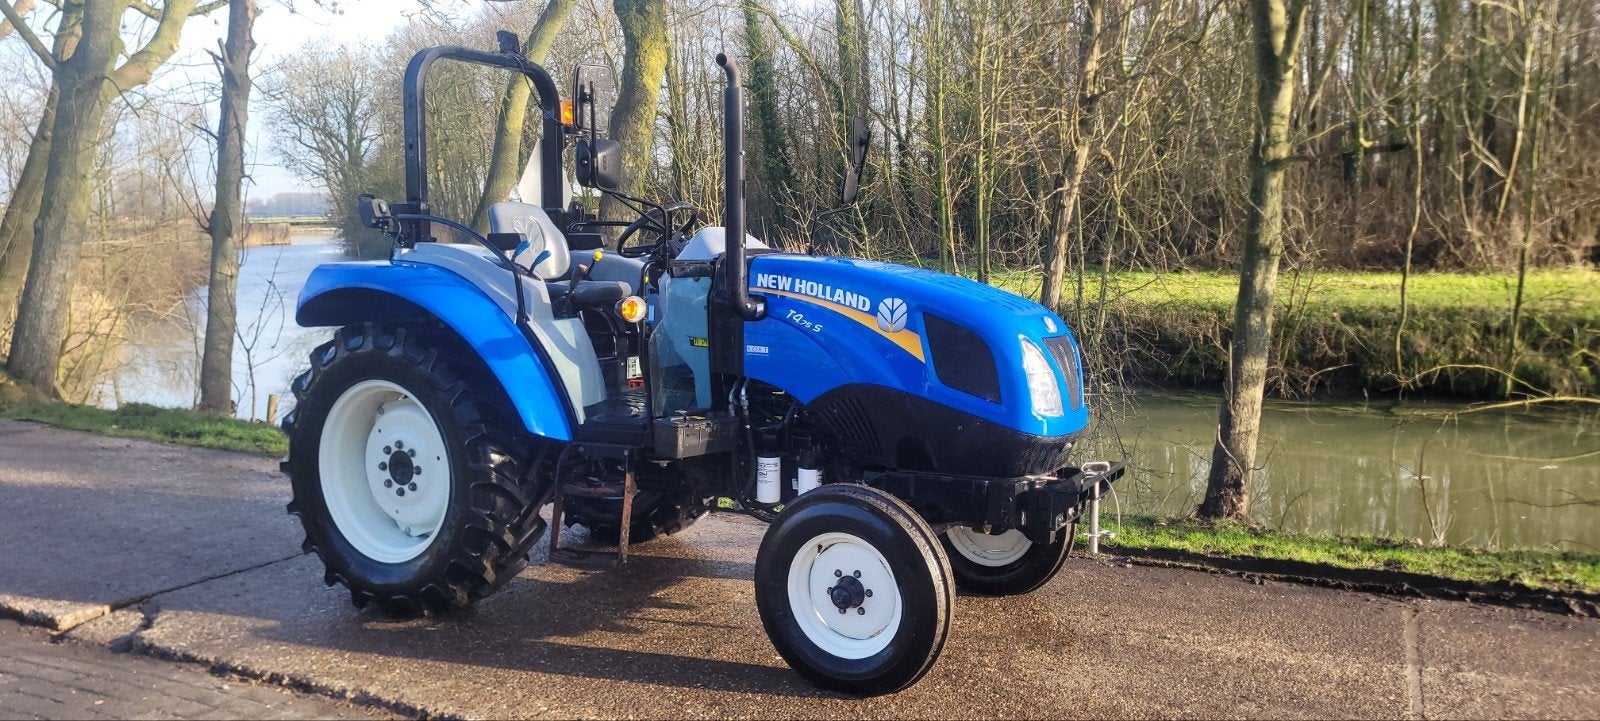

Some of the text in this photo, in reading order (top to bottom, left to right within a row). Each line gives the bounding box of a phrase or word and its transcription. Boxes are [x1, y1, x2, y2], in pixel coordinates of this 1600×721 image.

[756, 273, 871, 312] NEW HOLLAND
[812, 324, 823, 333] S
